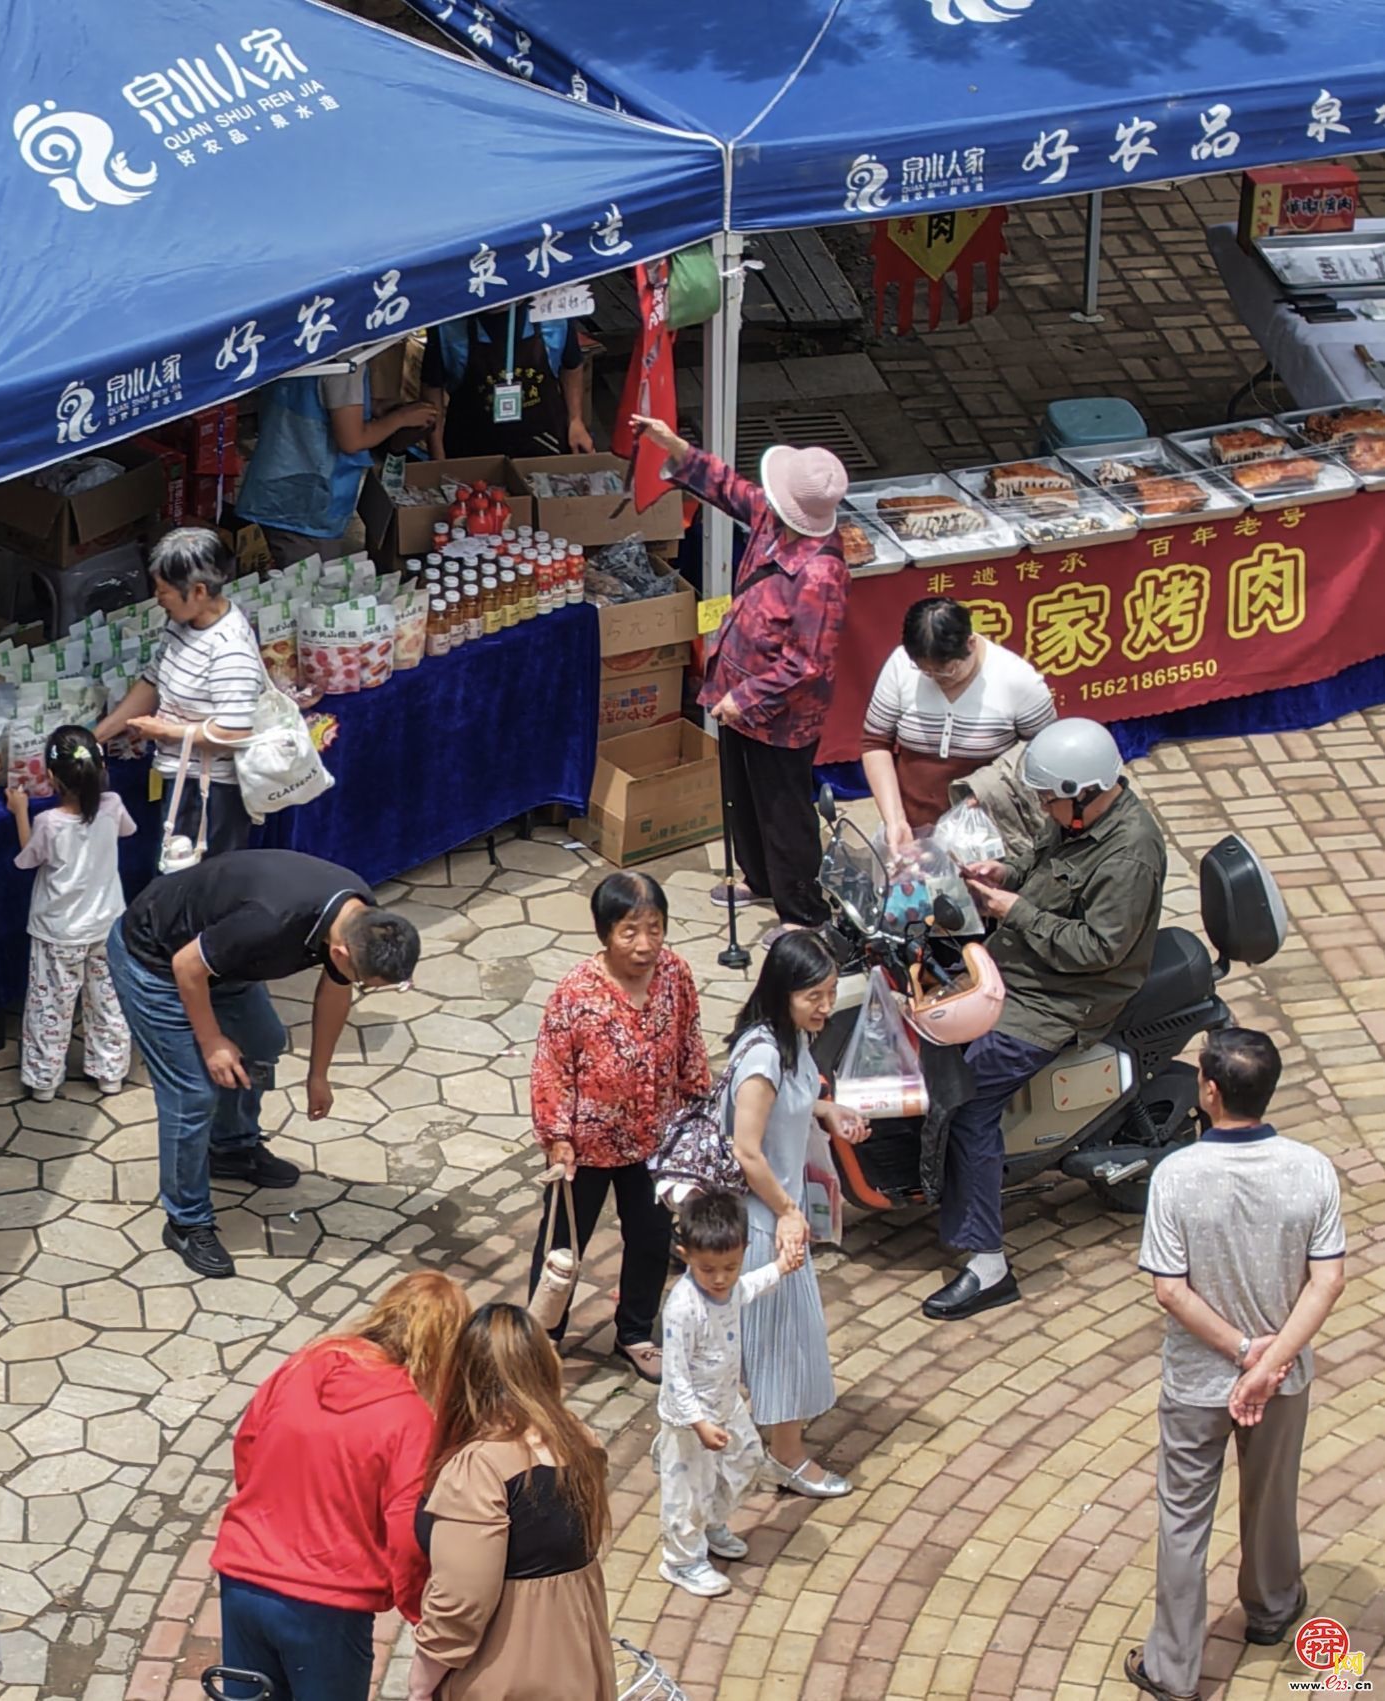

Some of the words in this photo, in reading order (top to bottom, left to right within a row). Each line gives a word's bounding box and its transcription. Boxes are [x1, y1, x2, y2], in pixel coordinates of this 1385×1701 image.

[122, 28, 308, 134] 泉水人家
[163, 121, 213, 150] QUAN
[214, 104, 257, 128] SHUI
[257, 90, 295, 111] REN
[299, 79, 325, 98] JIA
[902, 148, 985, 185] 泉水人家
[1022, 103, 1240, 185] 好农品
[1307, 89, 1385, 142] 泉
[215, 270, 411, 382] 好农品
[469, 203, 633, 298] 泉水造
[106, 353, 181, 407] 泉水人家
[927, 552, 1087, 594] 非遗传承
[1146, 507, 1306, 558] 百年老号
[960, 543, 1305, 676] 家烤肉
[1080, 659, 1218, 700] 15621865550
